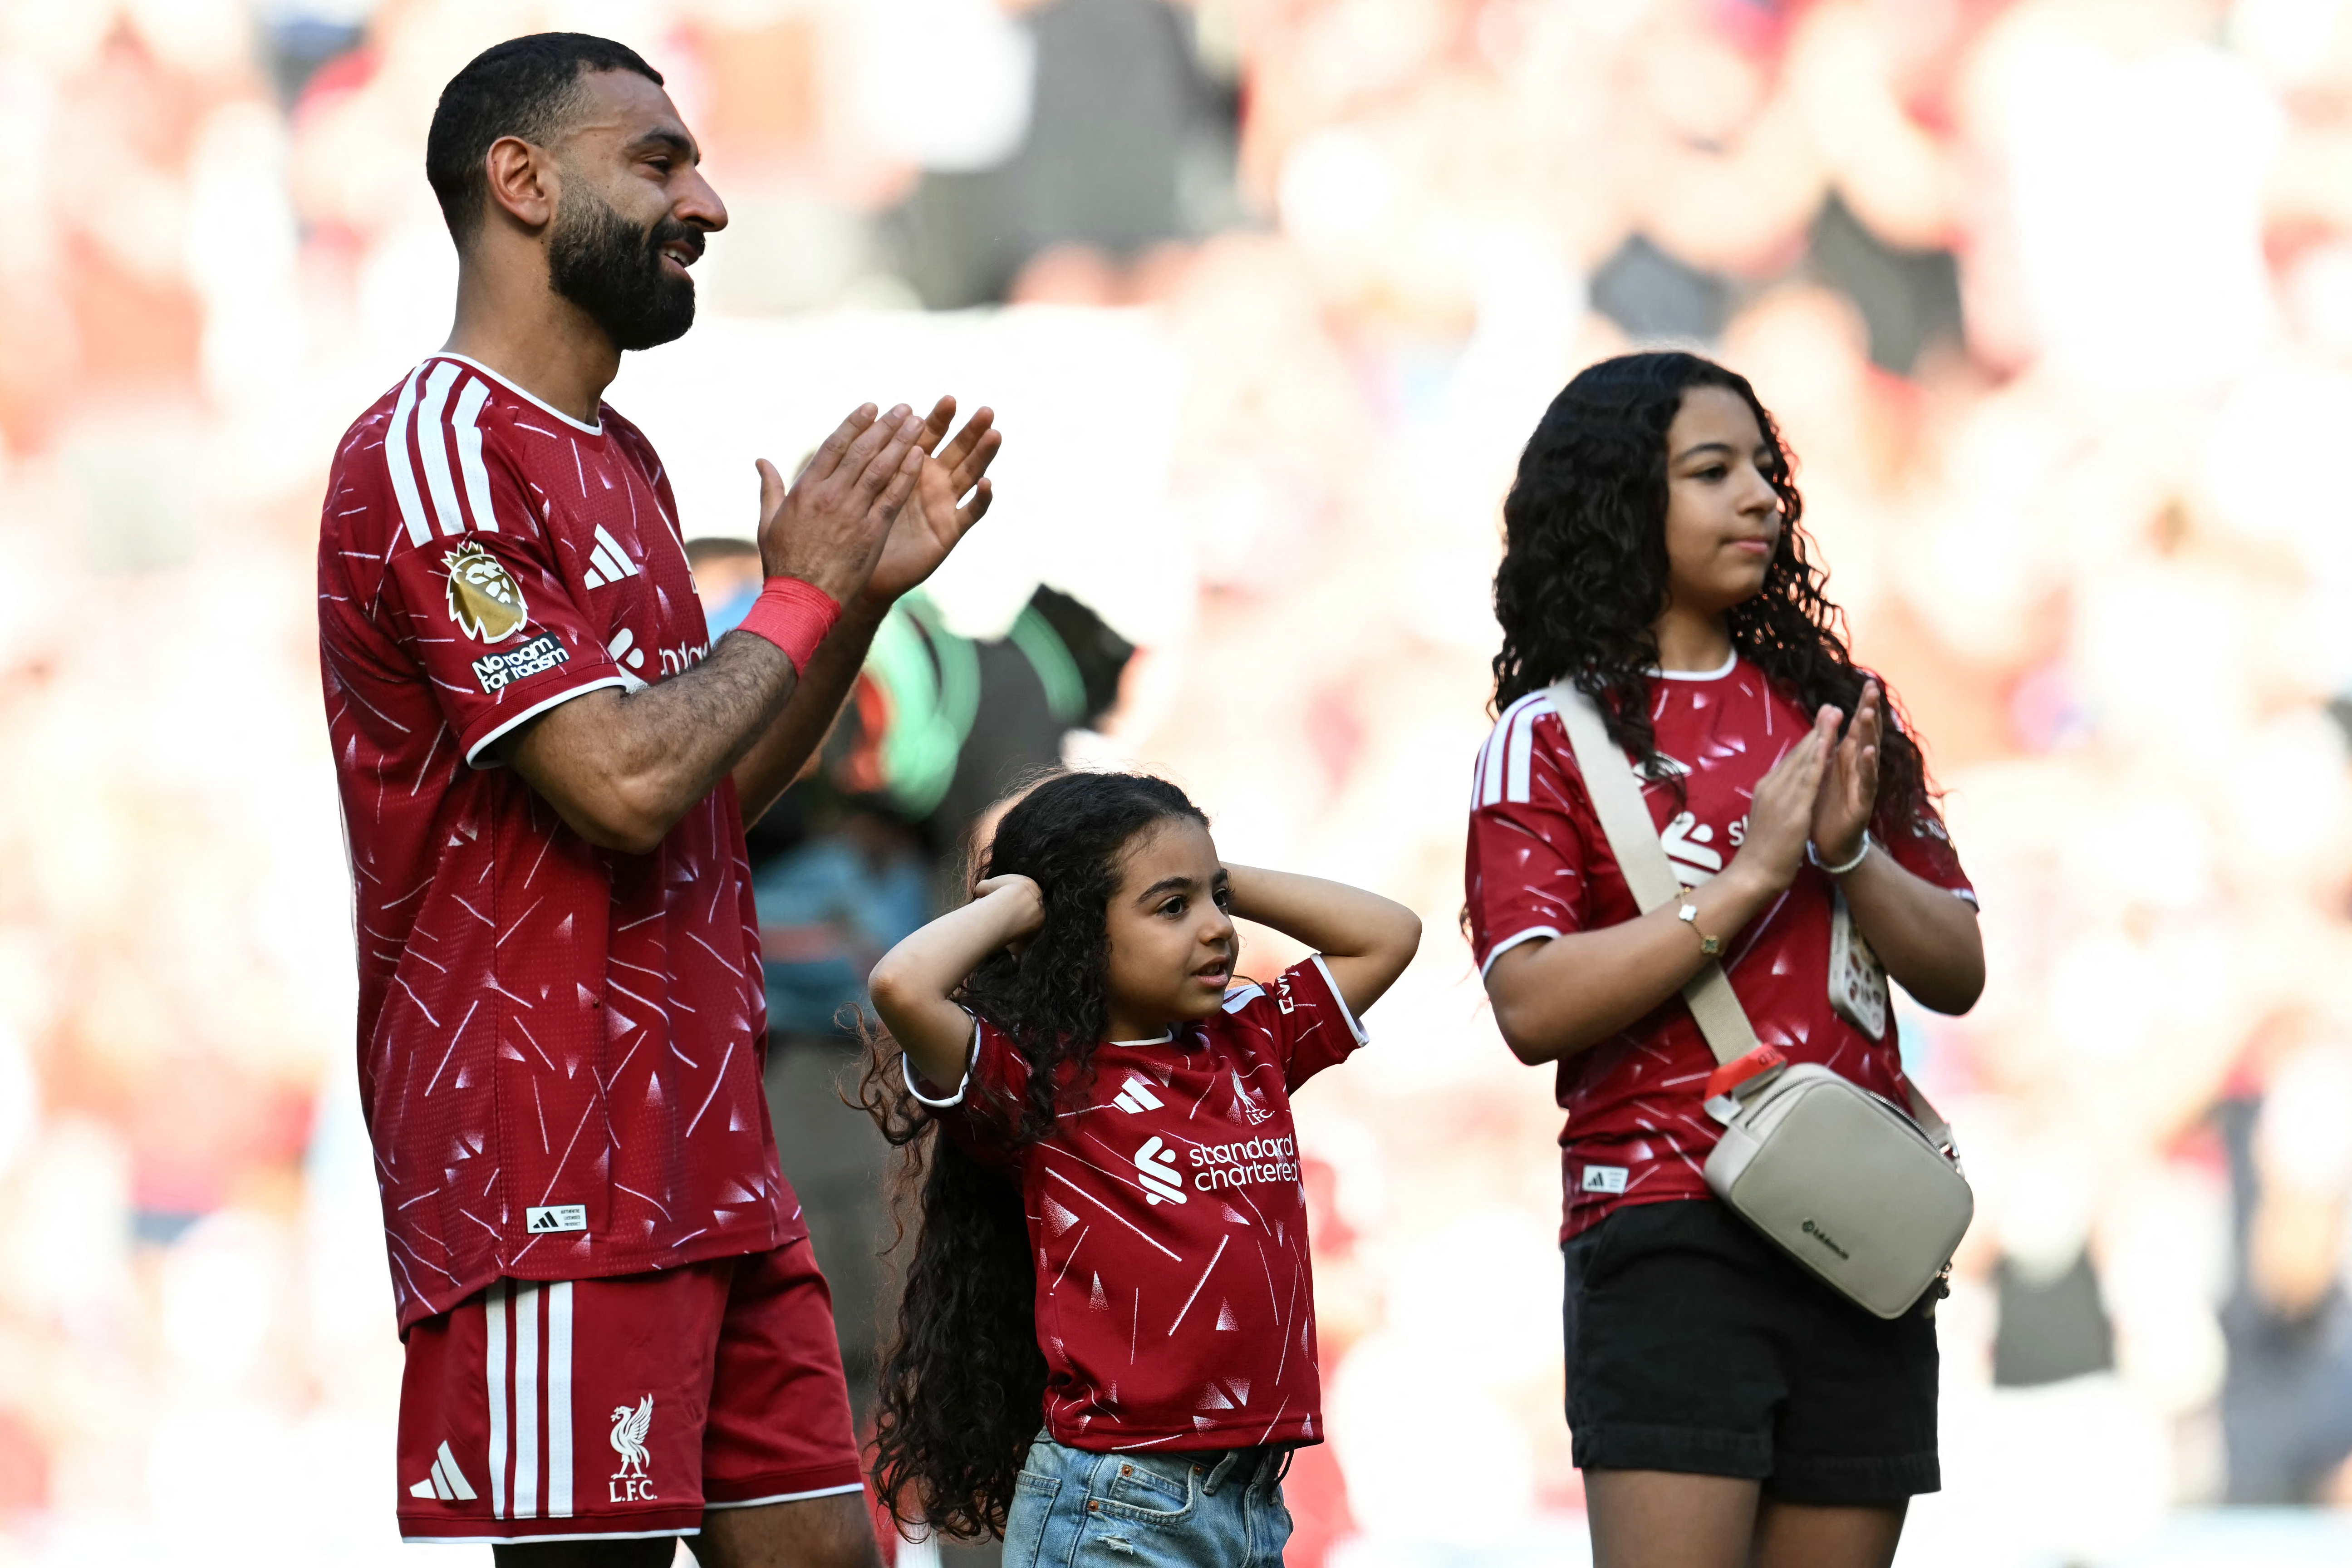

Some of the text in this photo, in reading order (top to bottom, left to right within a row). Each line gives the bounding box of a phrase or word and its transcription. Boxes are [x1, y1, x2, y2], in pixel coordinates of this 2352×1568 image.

[471, 638, 554, 679] No room
[481, 648, 570, 694] for racism
[1246, 1109, 1275, 1125] L.F.C.
[1189, 1133, 1293, 1167] standard
[1195, 1158, 1298, 1191] chartered
[609, 1480, 658, 1503] L.F.C.
